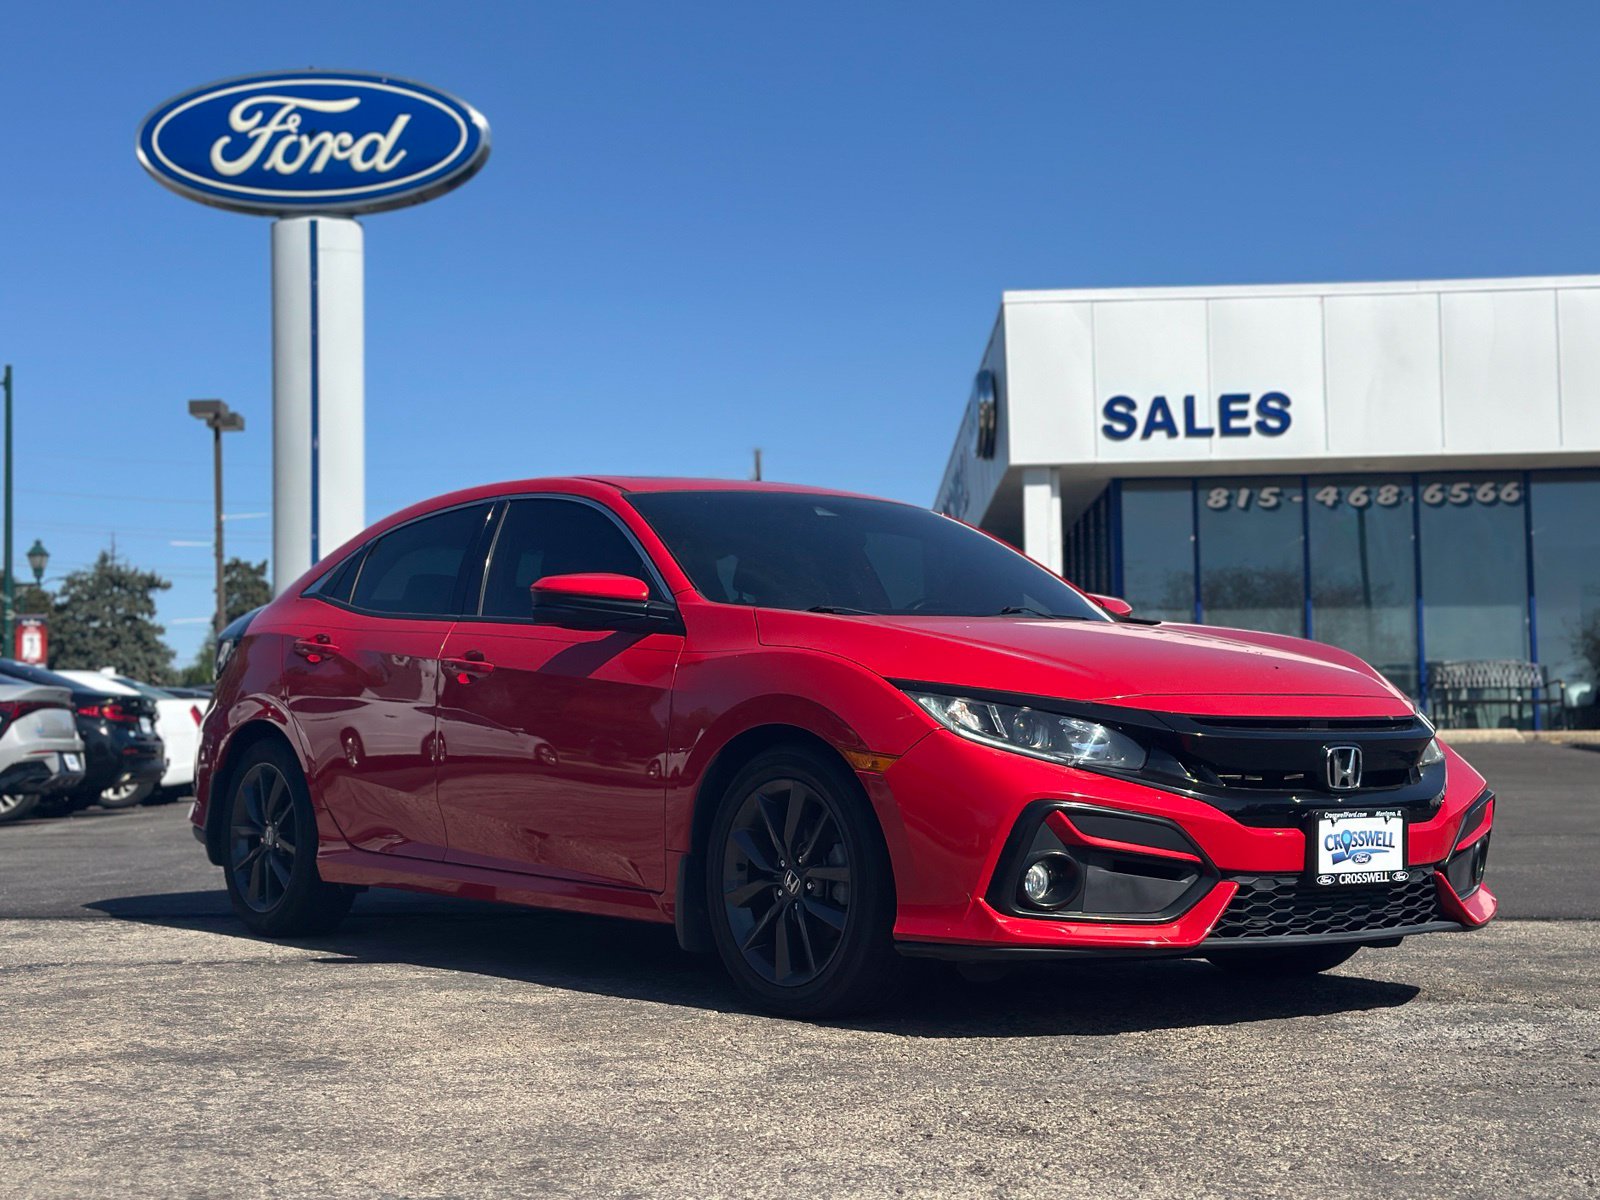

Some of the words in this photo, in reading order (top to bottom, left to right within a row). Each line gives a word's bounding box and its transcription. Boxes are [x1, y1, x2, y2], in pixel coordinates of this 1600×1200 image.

[210, 95, 411, 176] Ford
[1101, 391, 1292, 441] SALES
[1339, 872, 1390, 885] CROSSWELL
